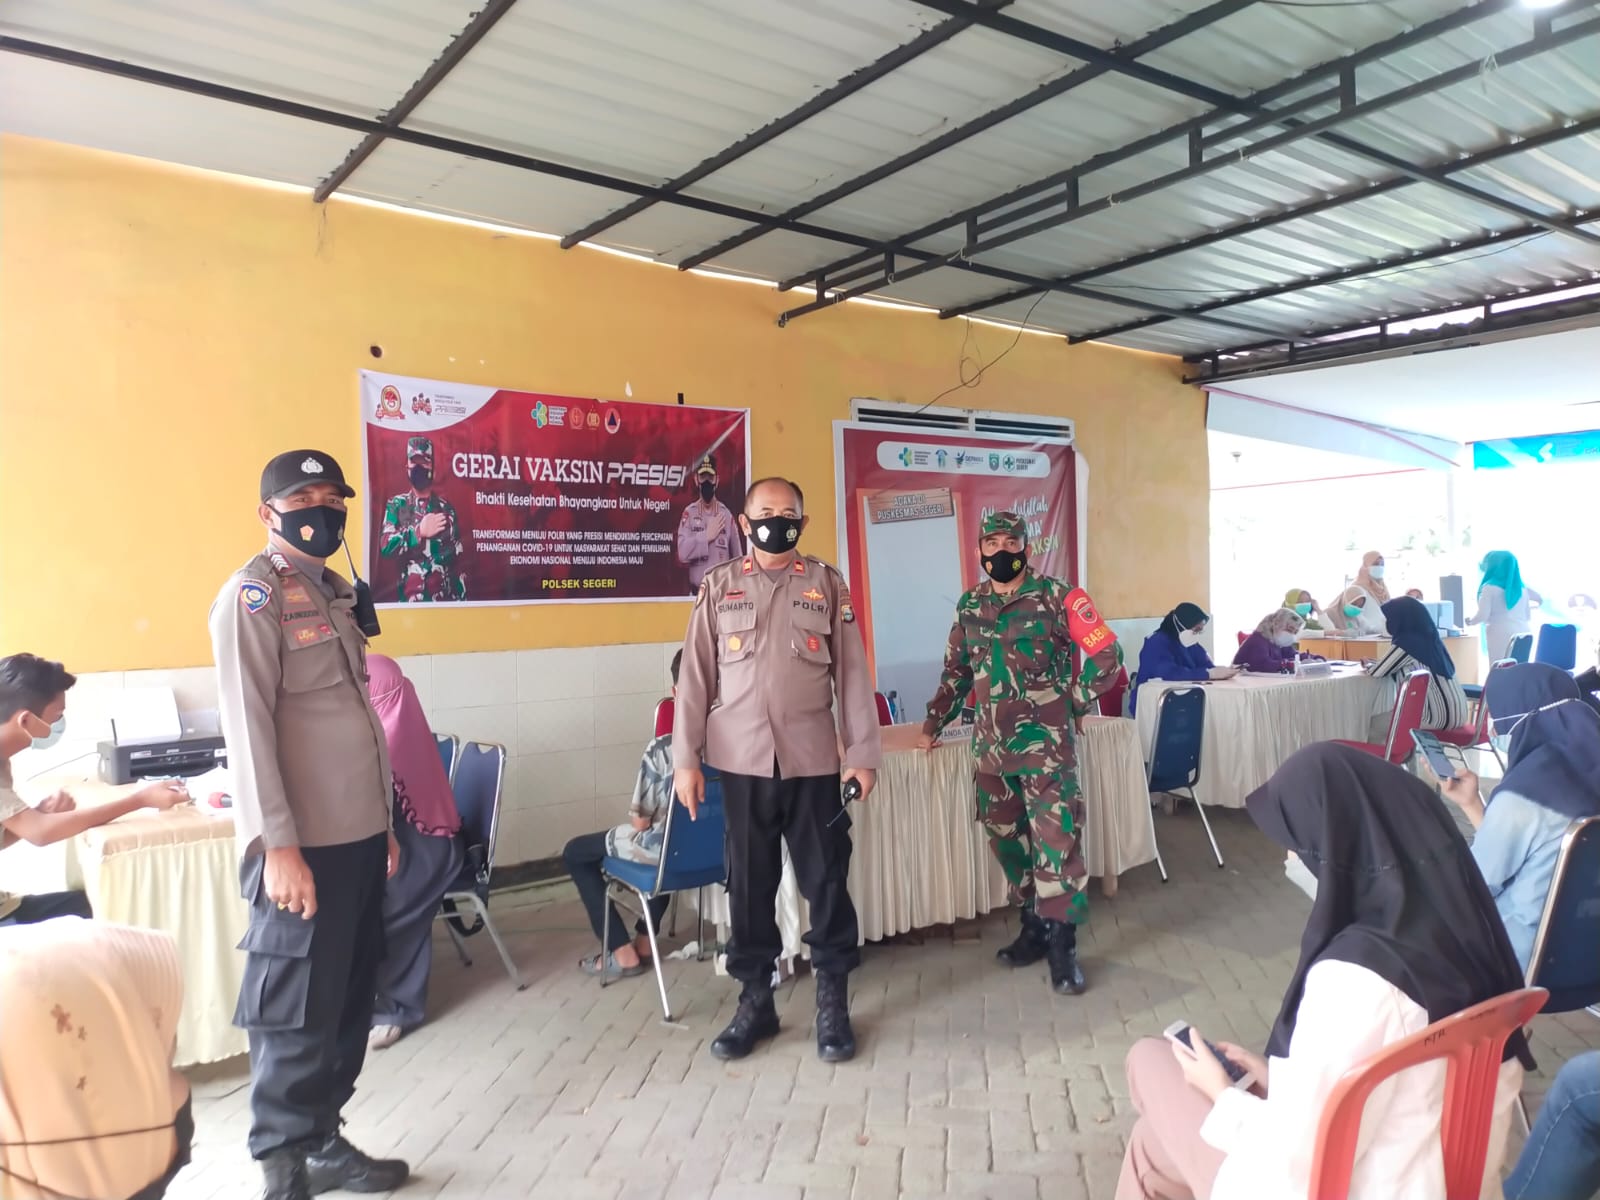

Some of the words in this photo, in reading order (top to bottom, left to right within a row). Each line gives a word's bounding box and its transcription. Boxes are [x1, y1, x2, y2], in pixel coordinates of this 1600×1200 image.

[452, 453, 521, 480] GERAI
[525, 457, 603, 484] VAKSIN
[606, 462, 687, 486] PRESISI
[475, 491, 506, 506] Bhakti
[507, 492, 557, 507] Kesehatan
[559, 494, 617, 512] Bhayangkara
[619, 496, 642, 510] Untuk
[643, 498, 670, 513] Negeri
[472, 529, 521, 540] TRANSFORMASI
[521, 530, 547, 541] MENUJU
[547, 531, 565, 541] POLRI
[565, 531, 583, 541] YANG
[583, 531, 604, 541] PRESISI
[604, 532, 640, 542] MENDUKUNG
[641, 532, 674, 542] PERCEPATAN
[476, 542, 521, 553] PENANGANAN
[521, 543, 553, 553] COVID-19
[554, 543, 573, 553] UNTUK
[573, 543, 610, 553] MASYARAKAT
[610, 544, 628, 553] SEHAT
[628, 544, 641, 553] DAN
[641, 544, 671, 553] PEMULIHAN
[510, 555, 541, 565] EKONOMI
[541, 555, 571, 565] NASIONAL
[572, 556, 596, 565] MENUJU
[596, 556, 628, 565] INDONESIA
[628, 556, 644, 565] MAJU
[542, 579, 580, 590] POLSEK
[582, 578, 617, 589] SEGERI
[793, 600, 829, 614] POLRI
